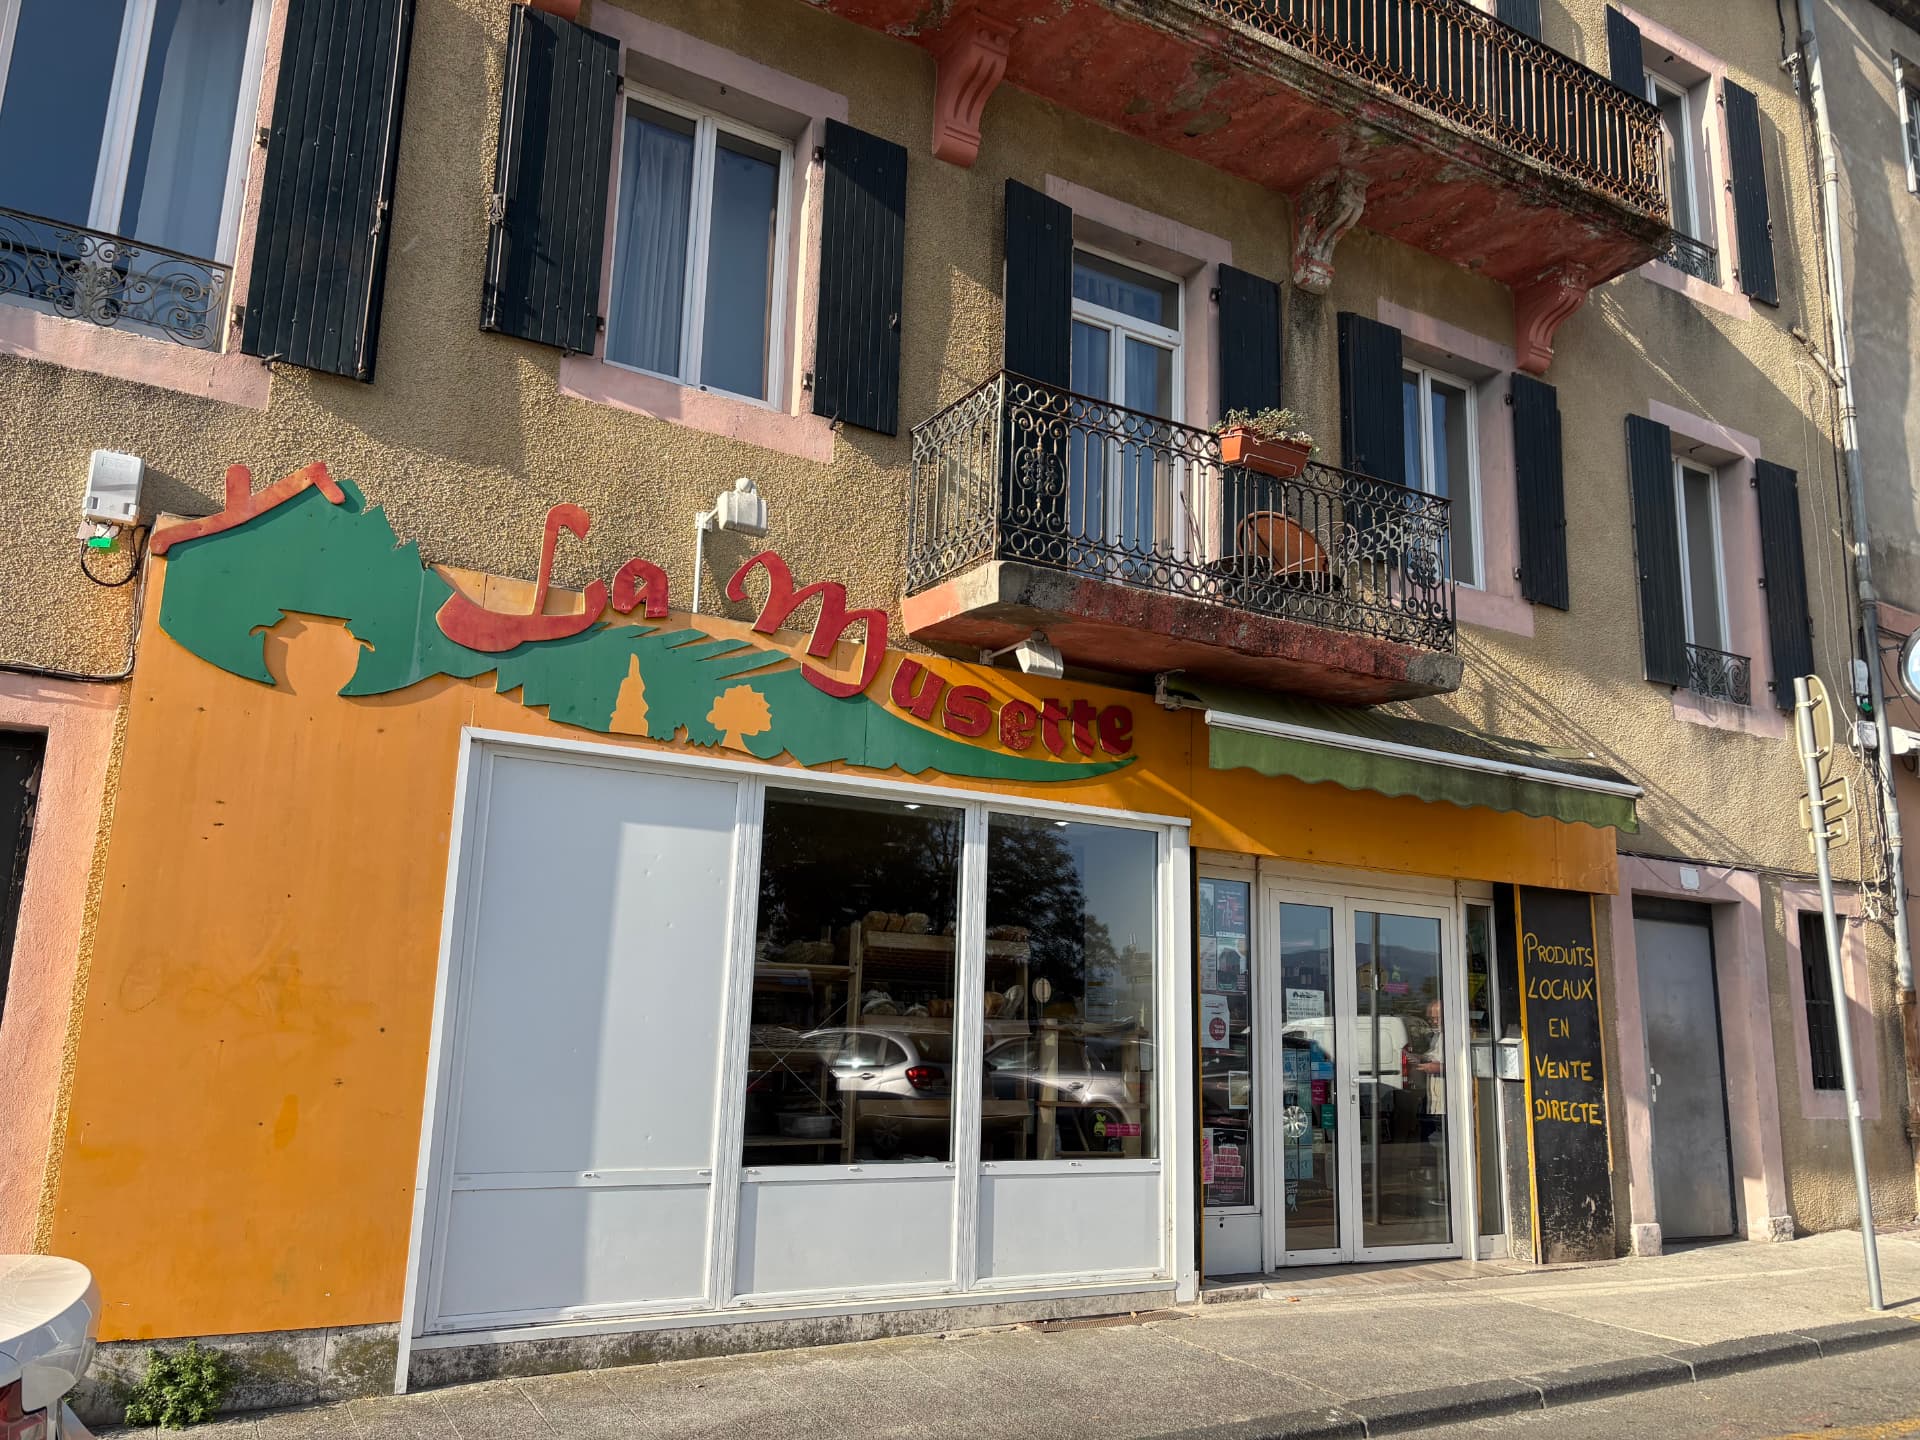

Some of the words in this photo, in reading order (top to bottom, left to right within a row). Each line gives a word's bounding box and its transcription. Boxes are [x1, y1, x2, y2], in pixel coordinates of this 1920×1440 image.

[435, 502, 669, 652] La
[724, 550, 1133, 757] Musette
[1528, 976, 1593, 1001] LOCAUX
[1549, 1018, 1570, 1039] EN
[1535, 1054, 1593, 1082] VENTE
